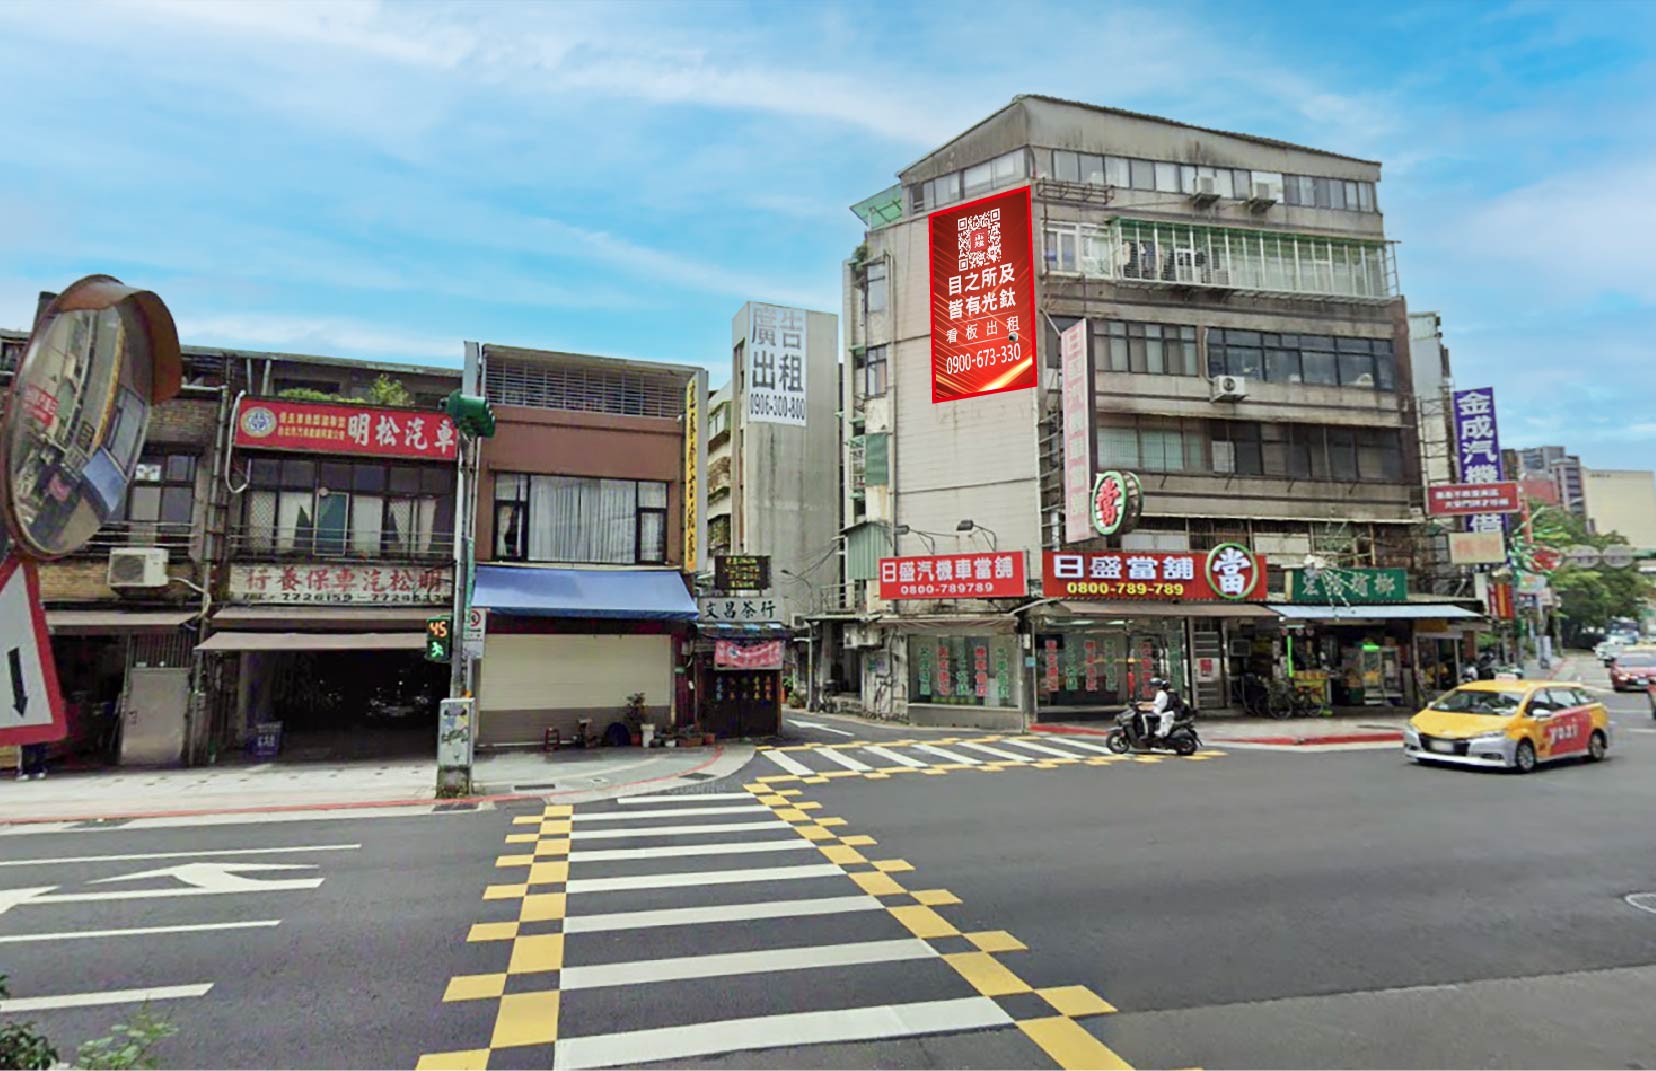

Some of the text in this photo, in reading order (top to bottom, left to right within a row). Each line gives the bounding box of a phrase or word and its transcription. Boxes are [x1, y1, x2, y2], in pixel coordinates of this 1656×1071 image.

[948, 263, 1015, 296] 目之所及
[948, 287, 1016, 320] 皆有光鈦
[946, 316, 1019, 344] 看板出租
[752, 351, 803, 392] 出租
[946, 343, 1020, 374] 0900-673-330
[347, 412, 454, 454] 明松汽車
[1212, 547, 1250, 593] 當
[900, 582, 993, 595] 0800-789789
[1067, 581, 1184, 596] 0800-789-789
[705, 600, 776, 619] 文昌茶行
[429, 621, 447, 637] 45
